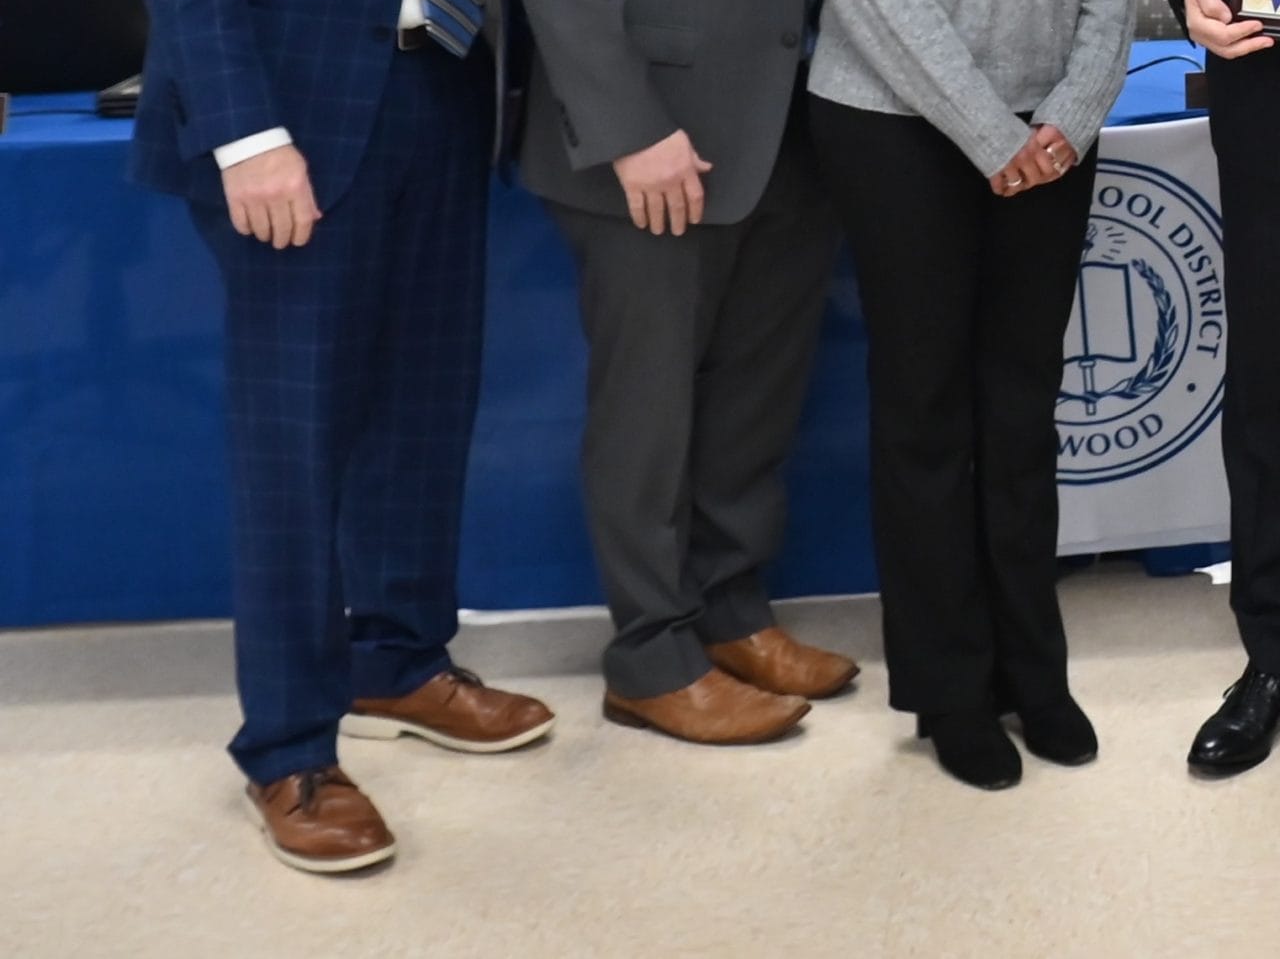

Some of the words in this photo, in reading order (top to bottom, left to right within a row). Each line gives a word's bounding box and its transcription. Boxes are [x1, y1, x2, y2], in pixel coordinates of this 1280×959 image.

[1098, 186, 1166, 230] OOL
[1168, 222, 1223, 360] DISTRICT
[1057, 413, 1163, 457] WOOD
